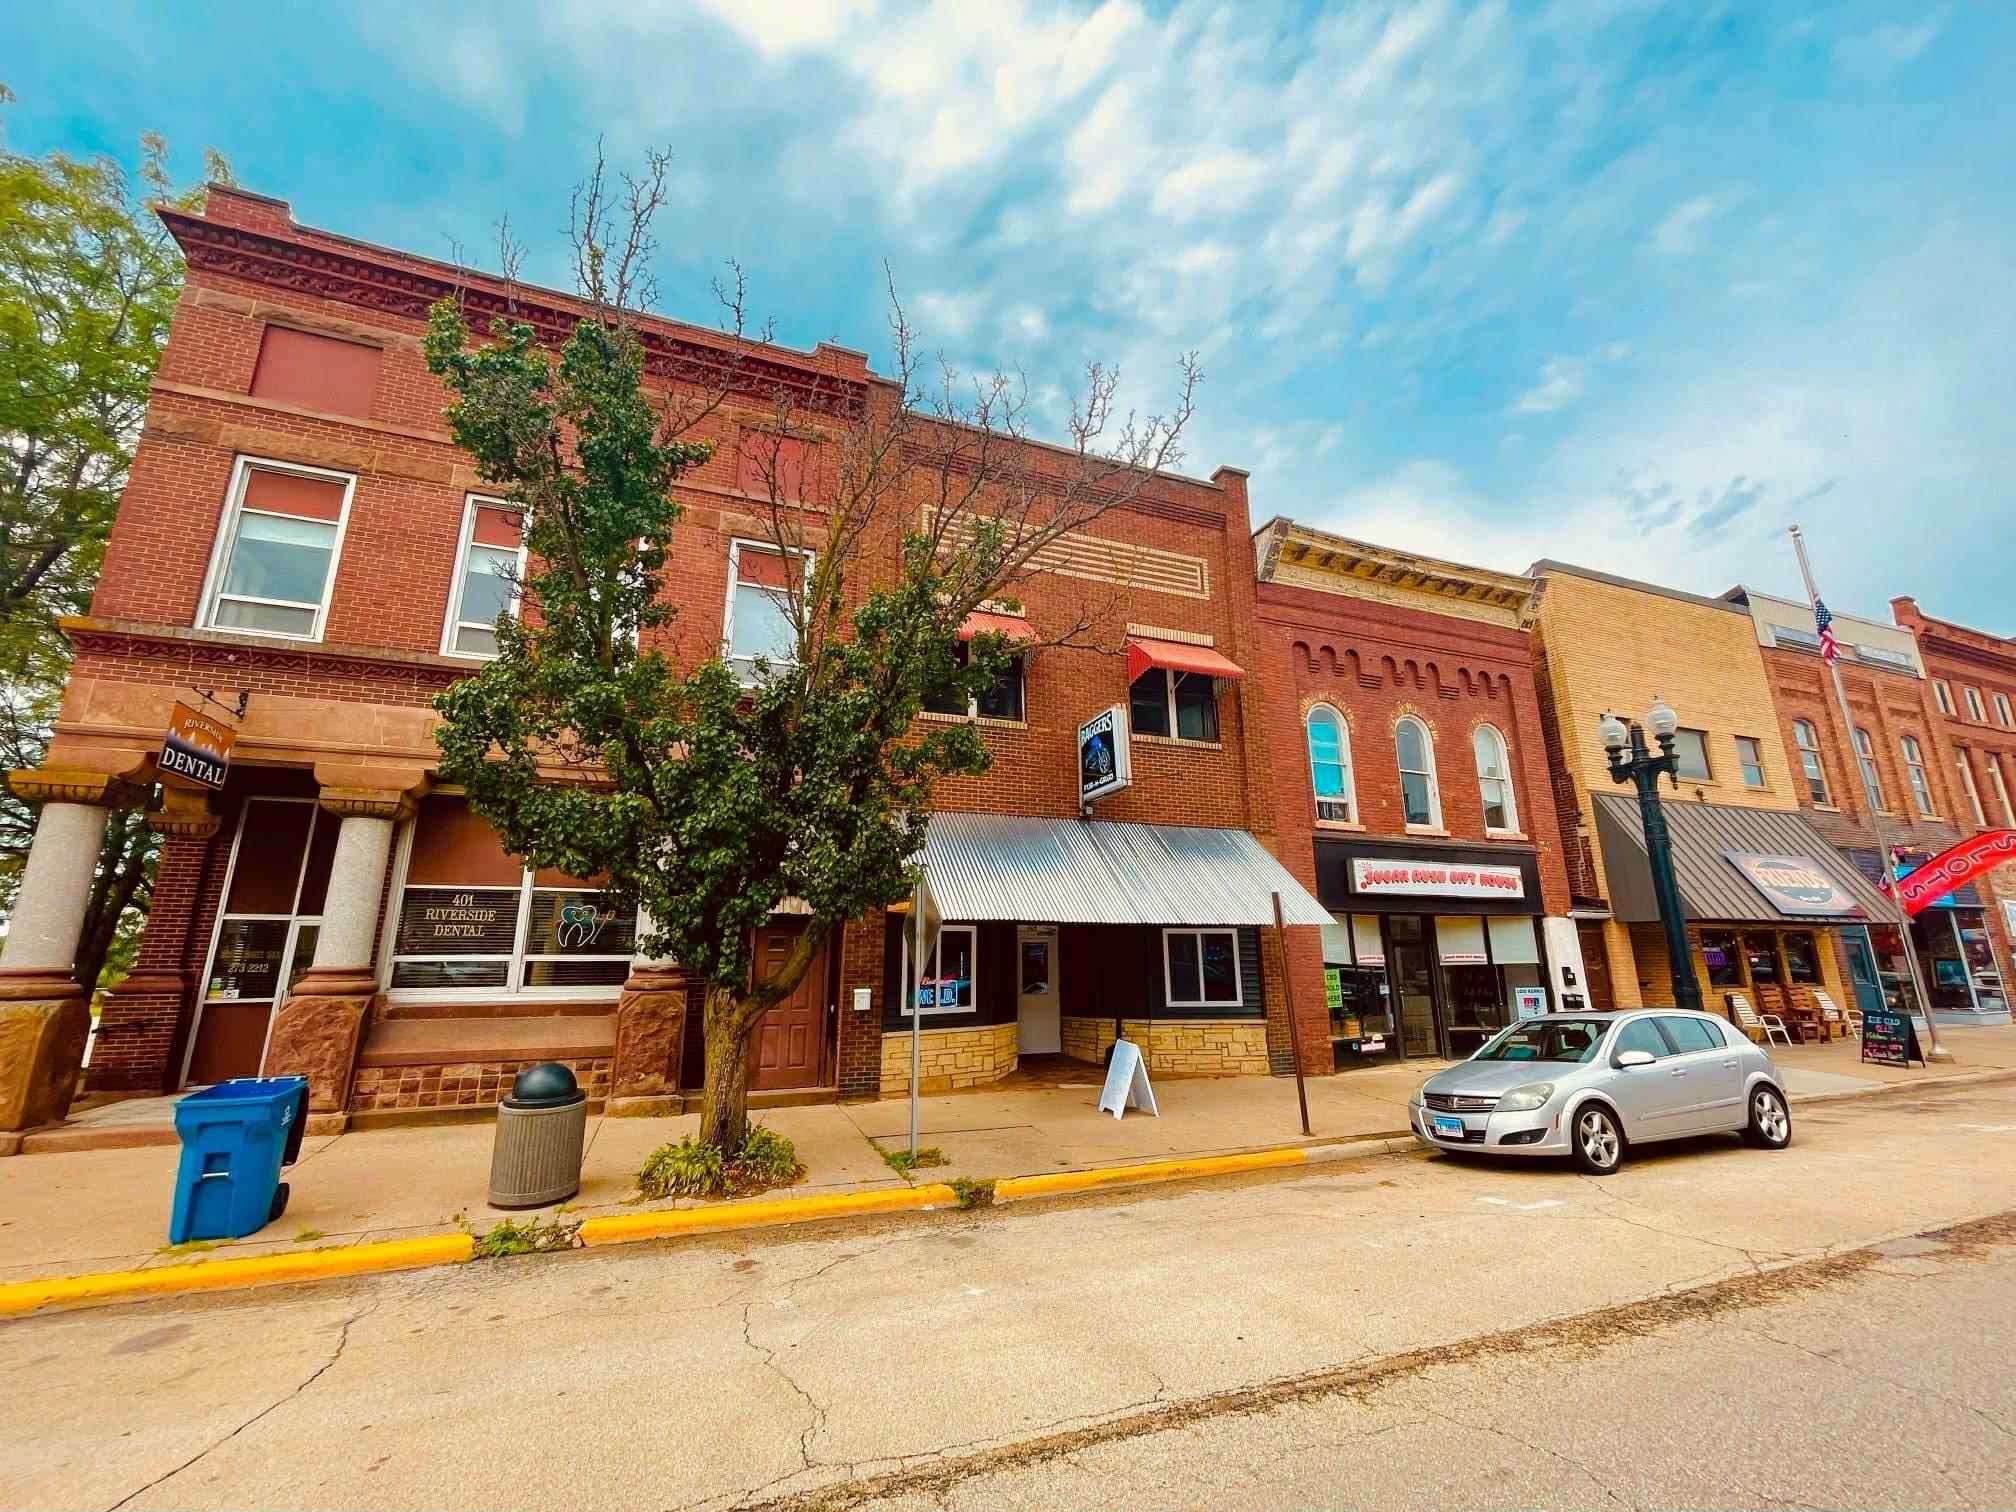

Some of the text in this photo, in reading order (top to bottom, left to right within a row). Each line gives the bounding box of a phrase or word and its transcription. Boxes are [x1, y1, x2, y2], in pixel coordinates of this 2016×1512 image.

[1081, 713, 1112, 748] BAGGERS
[161, 747, 224, 784] DENTAL
[1904, 834, 2016, 900] SLOTS
[1366, 869, 1518, 890] SUGAR RUSH GIFT HOUSE
[452, 895, 474, 906] 401
[424, 908, 497, 921] RIVERSIDE
[433, 925, 486, 937] DENTAL
